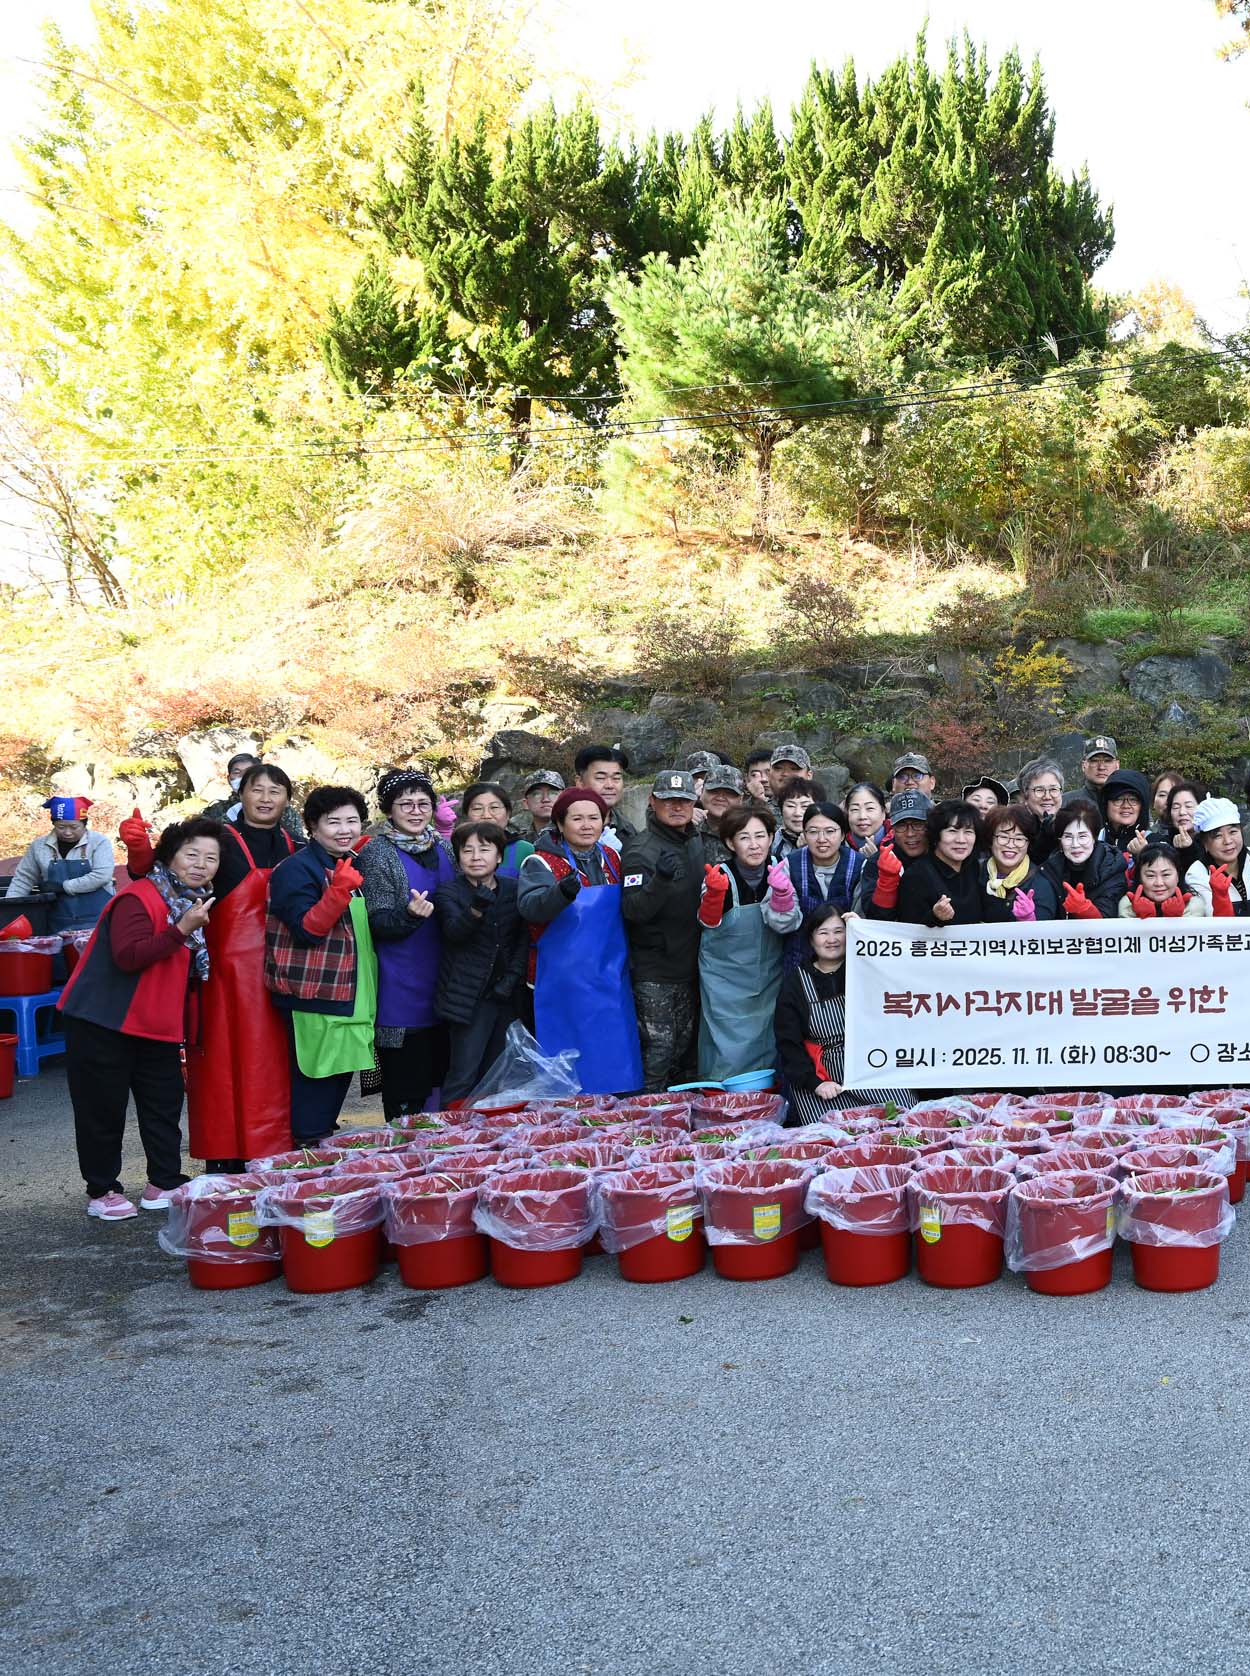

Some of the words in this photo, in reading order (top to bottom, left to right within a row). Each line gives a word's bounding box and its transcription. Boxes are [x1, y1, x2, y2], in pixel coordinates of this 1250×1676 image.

[855, 939, 903, 957] 2025
[909, 935, 1141, 958] 홍성군지역사회보장협의체
[882, 989, 1063, 1019] 복지사각지대
[1069, 986, 1161, 1017] 발굴을
[1166, 984, 1229, 1014] 위한
[951, 1047, 1006, 1067] 2025.
[1012, 1047, 1030, 1065] 11.
[1035, 1047, 1053, 1065] 11.
[1060, 1044, 1096, 1065] (화)
